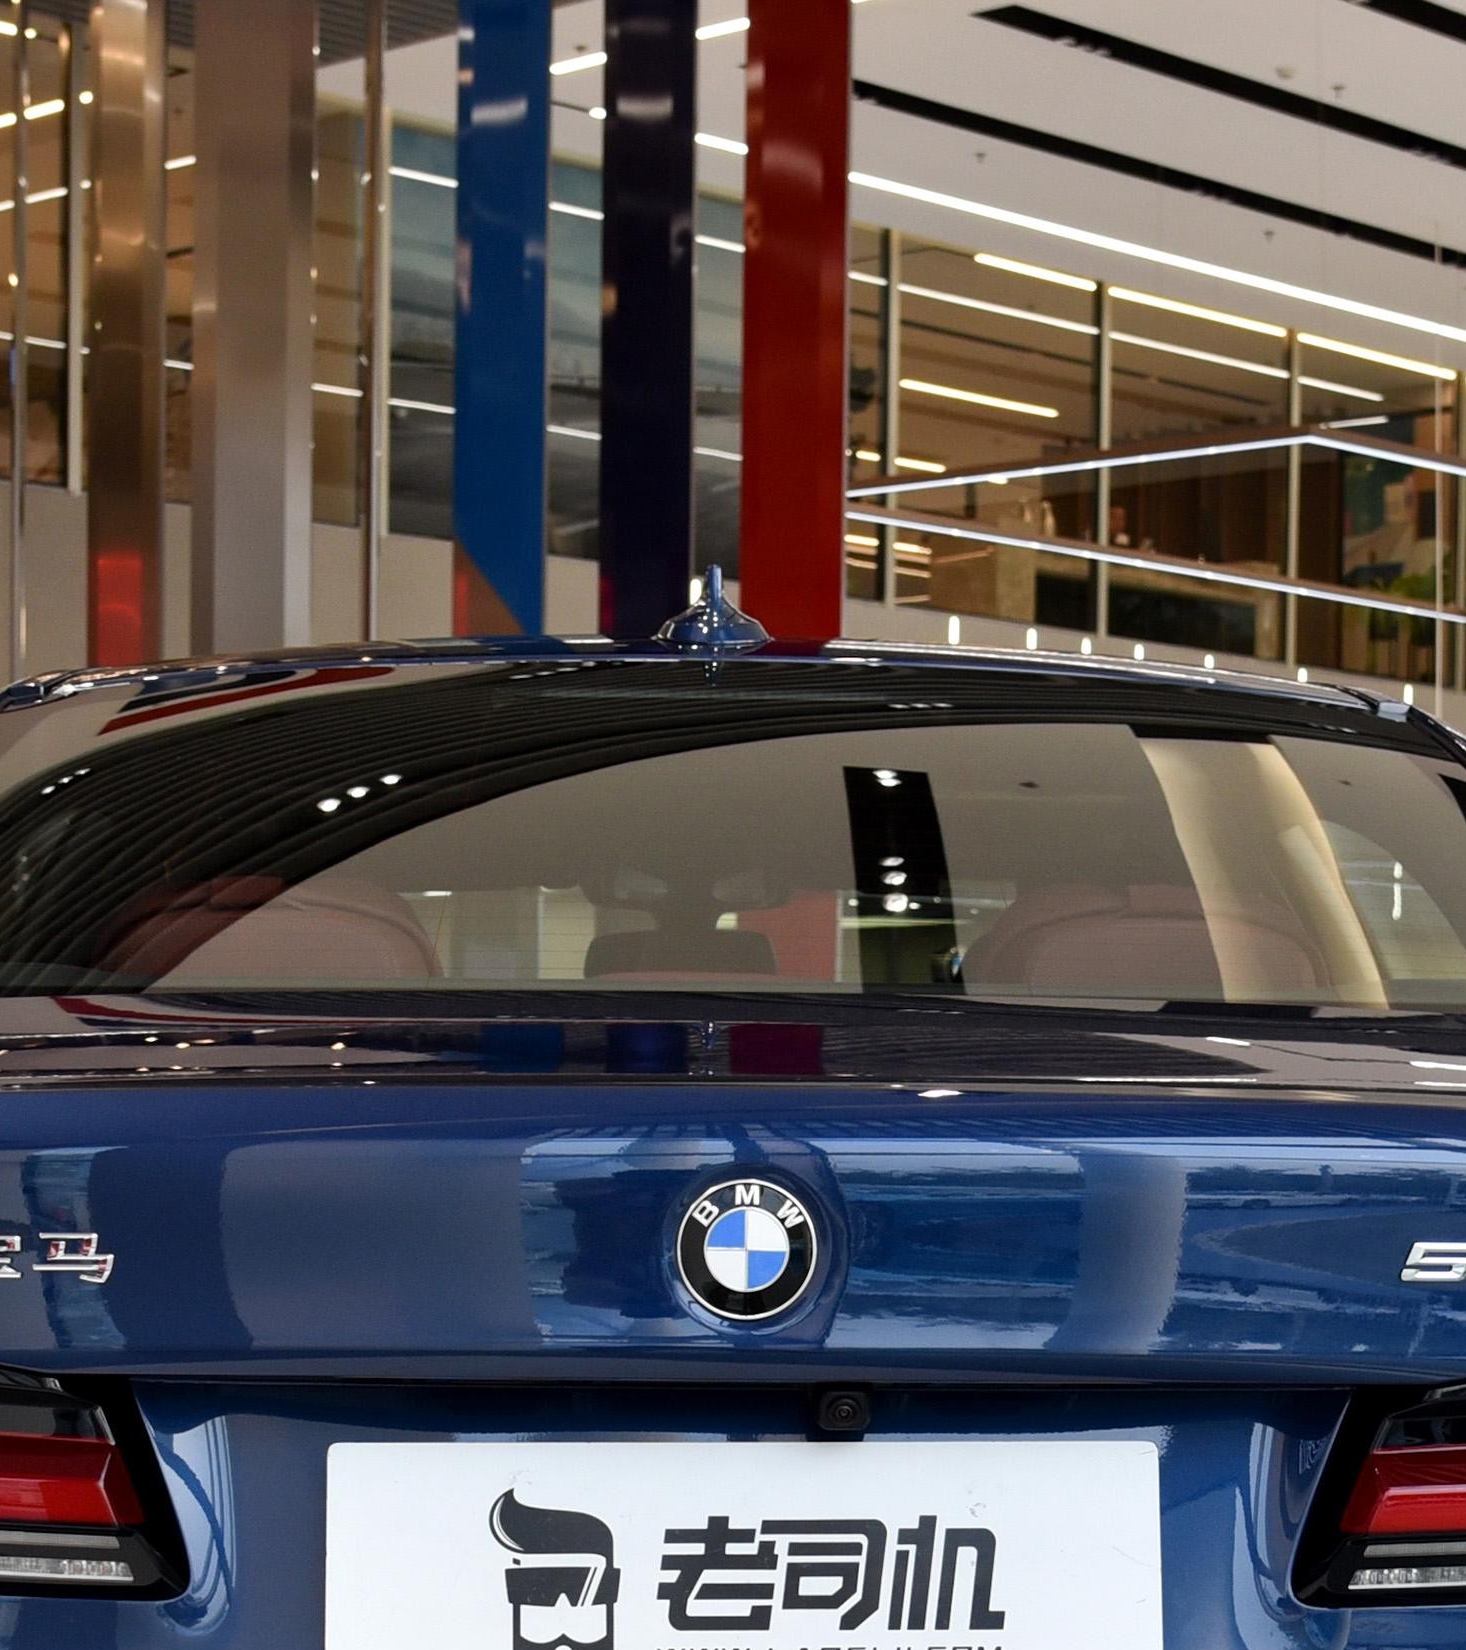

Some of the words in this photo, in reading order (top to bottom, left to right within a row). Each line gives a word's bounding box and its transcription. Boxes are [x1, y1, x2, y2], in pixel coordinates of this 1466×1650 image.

[691, 1183, 805, 1229] BMW
[656, 1515, 1006, 1631] 老司机
